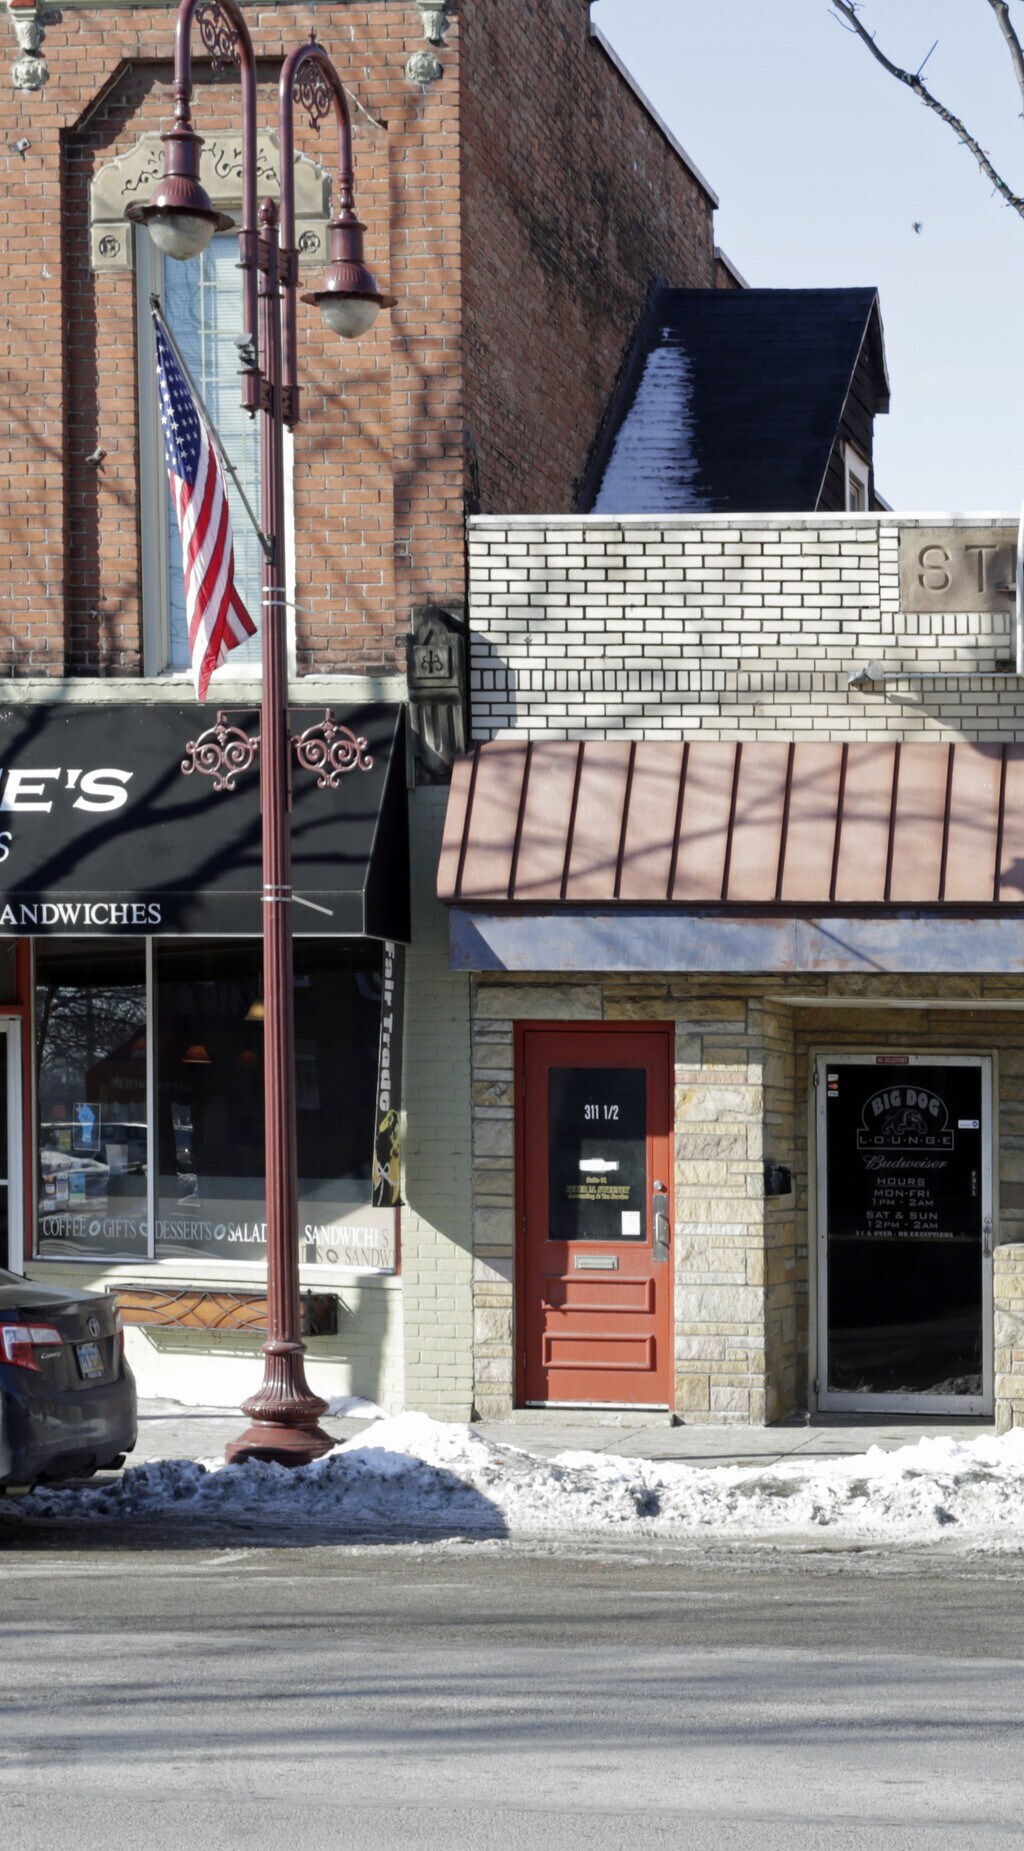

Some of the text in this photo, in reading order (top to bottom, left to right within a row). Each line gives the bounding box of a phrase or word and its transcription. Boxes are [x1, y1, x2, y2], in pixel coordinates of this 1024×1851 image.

[0, 767, 133, 813] E'S
[379, 942, 395, 1112] Fair Trade
[871, 1089, 940, 1117] BIG DOG
[584, 1104, 619, 1120] 311 1/2
[863, 1155, 948, 1170] Budweiser
[877, 1178, 926, 1186] HOURS
[874, 1189, 930, 1197] MON-FRI
[872, 1198, 895, 1206] 1PM
[909, 1198, 934, 1206] 2AM
[866, 1211, 890, 1219] SAT
[910, 1212, 938, 1220] SUN
[43, 1218, 86, 1238] COFFEE
[102, 1219, 137, 1239] GIFTS
[155, 1220, 212, 1240] DESSERTS
[867, 1220, 900, 1228] 12PM
[913, 1221, 938, 1229] 2AM
